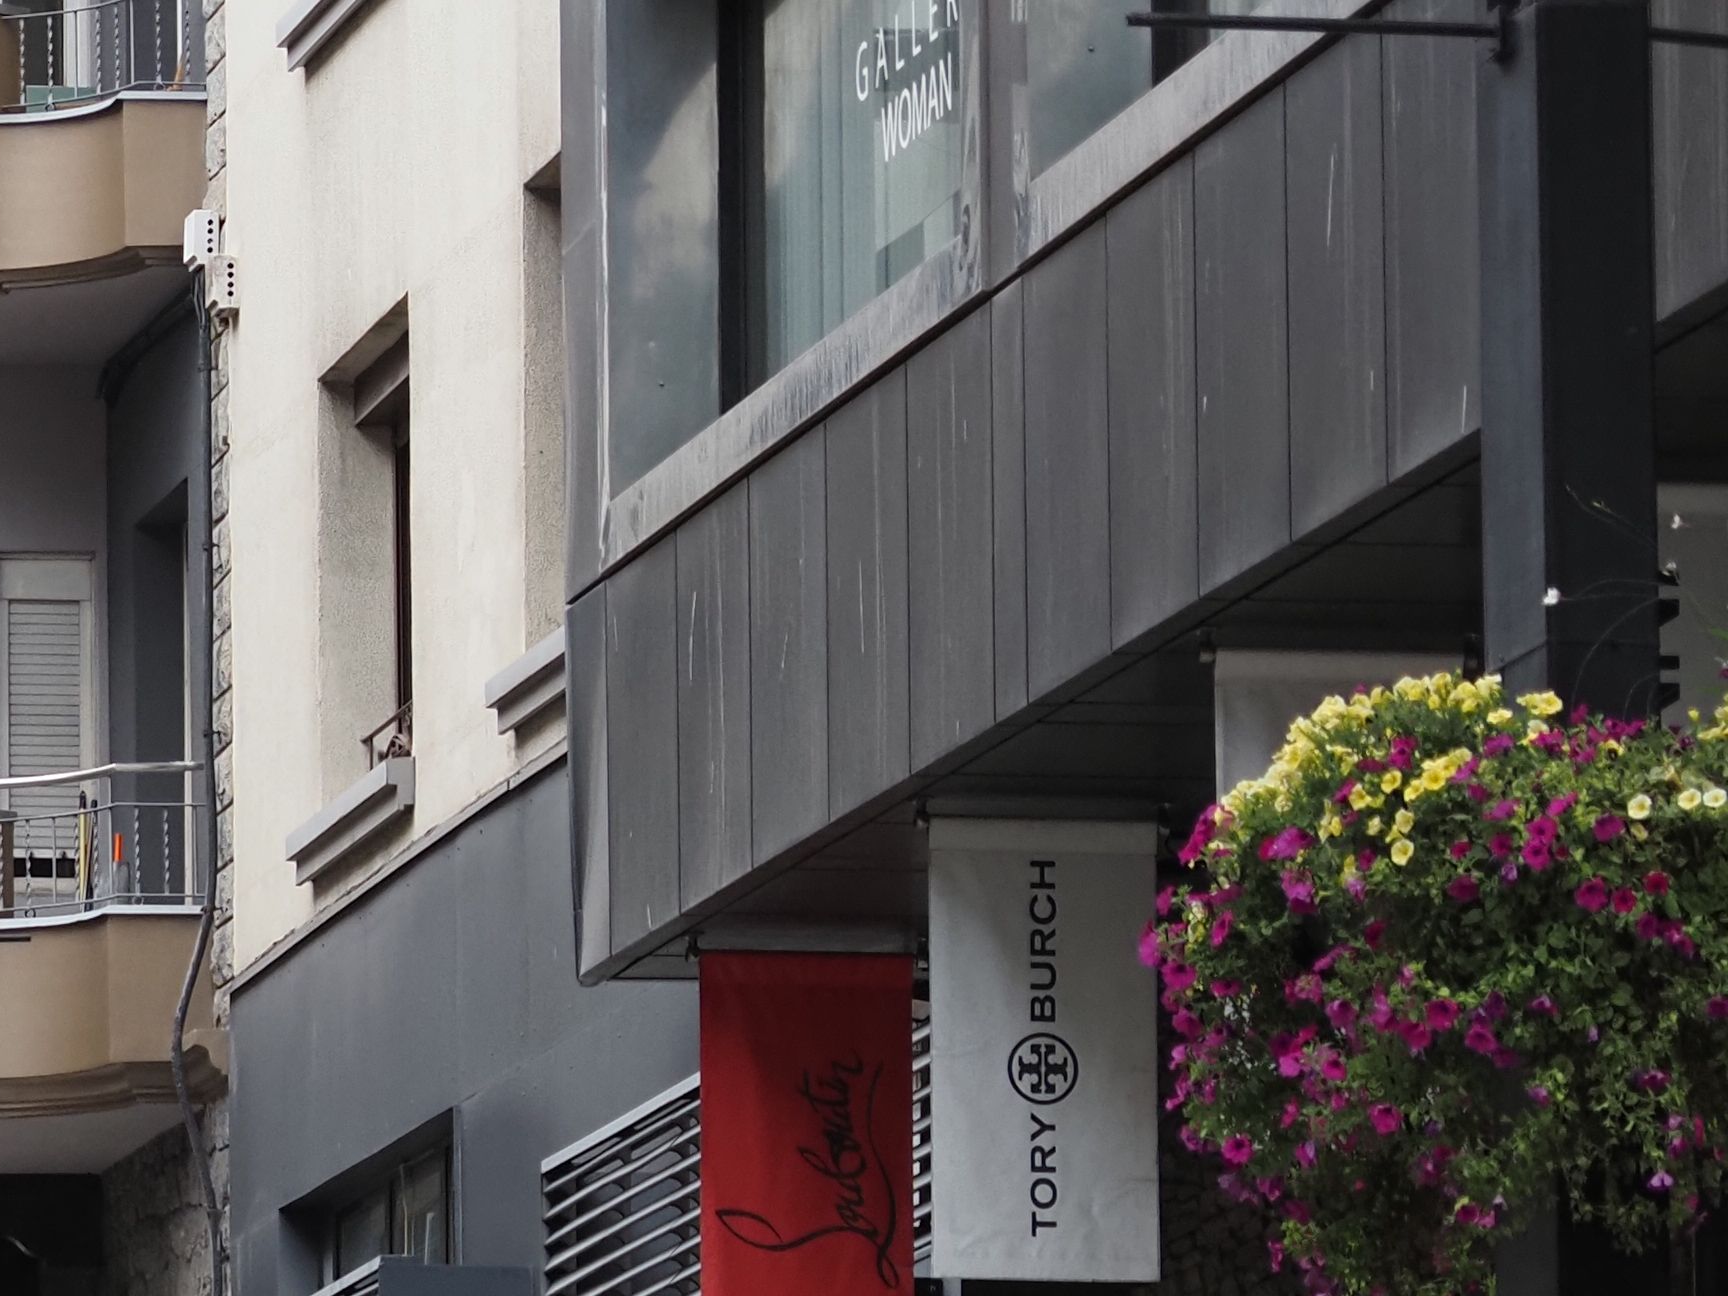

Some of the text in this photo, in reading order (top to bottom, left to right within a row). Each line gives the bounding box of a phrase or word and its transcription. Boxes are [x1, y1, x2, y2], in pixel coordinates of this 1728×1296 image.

[881, 52, 952, 162] WOMAN
[1029, 860, 1058, 1237] TORY BURCH
